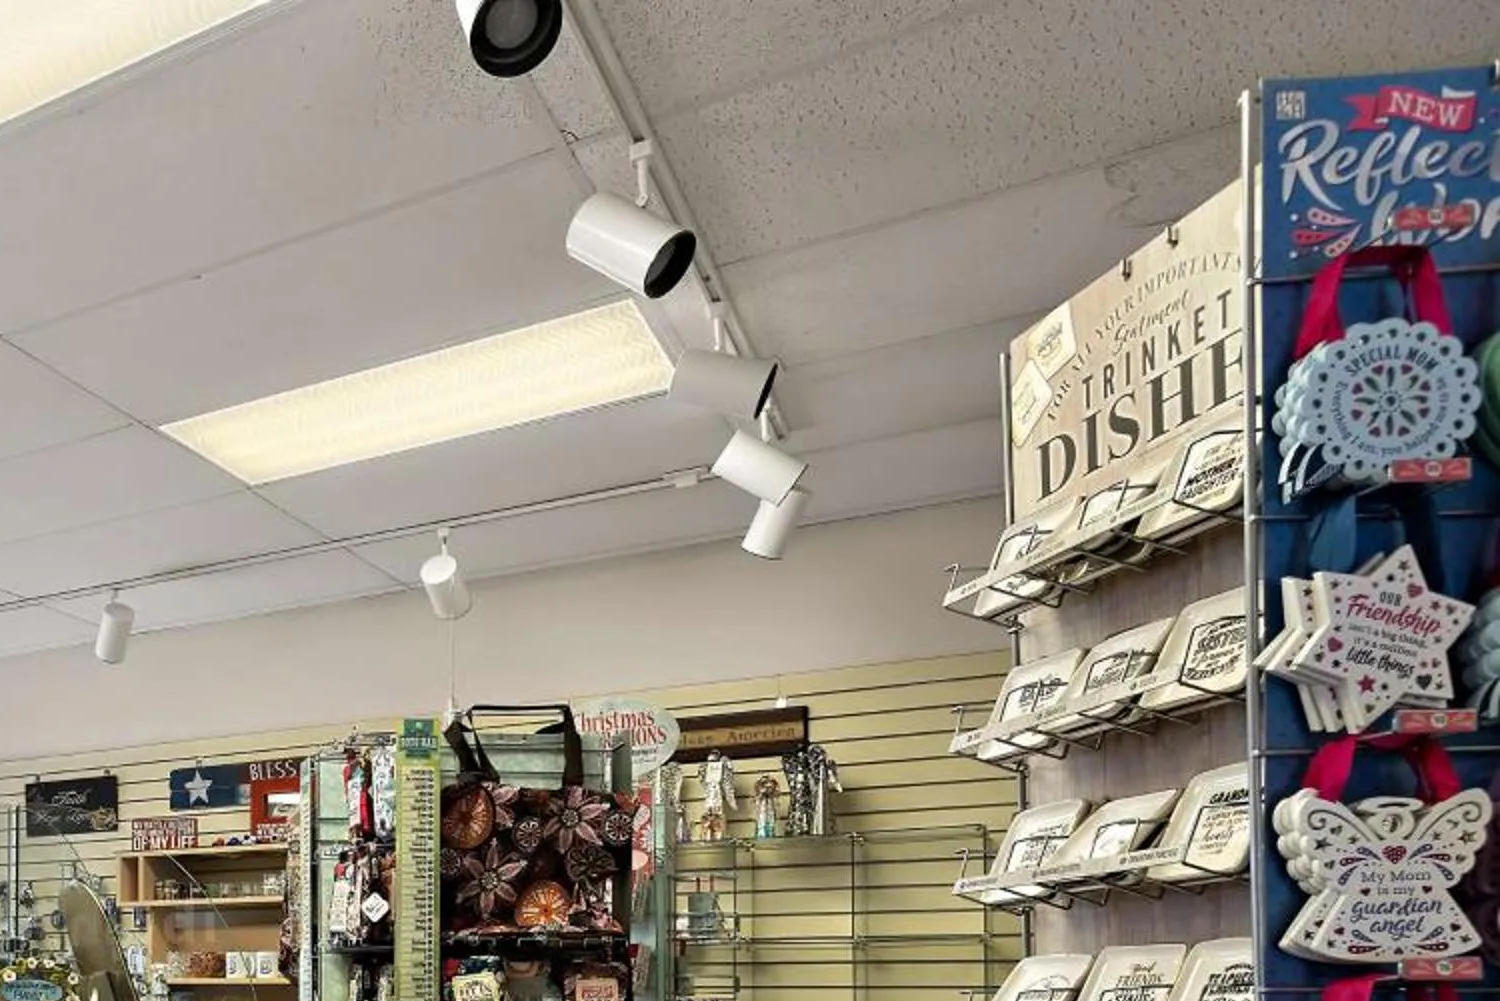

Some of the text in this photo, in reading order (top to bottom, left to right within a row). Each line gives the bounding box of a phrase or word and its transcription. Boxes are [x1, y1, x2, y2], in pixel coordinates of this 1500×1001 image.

[1388, 92, 1466, 128] NEW
[1082, 289, 1232, 410] TRINKET
[1345, 344, 1438, 376] SPECIAL MOM
[1036, 326, 1244, 502] DISHE
[1348, 594, 1441, 637] Friendship
[1345, 647, 1415, 679] little things
[249, 760, 297, 781] BLESS
[1361, 871, 1431, 884] My Mom
[1377, 884, 1415, 897] is my
[1351, 898, 1442, 923] guardian
[1369, 915, 1427, 941] angel
